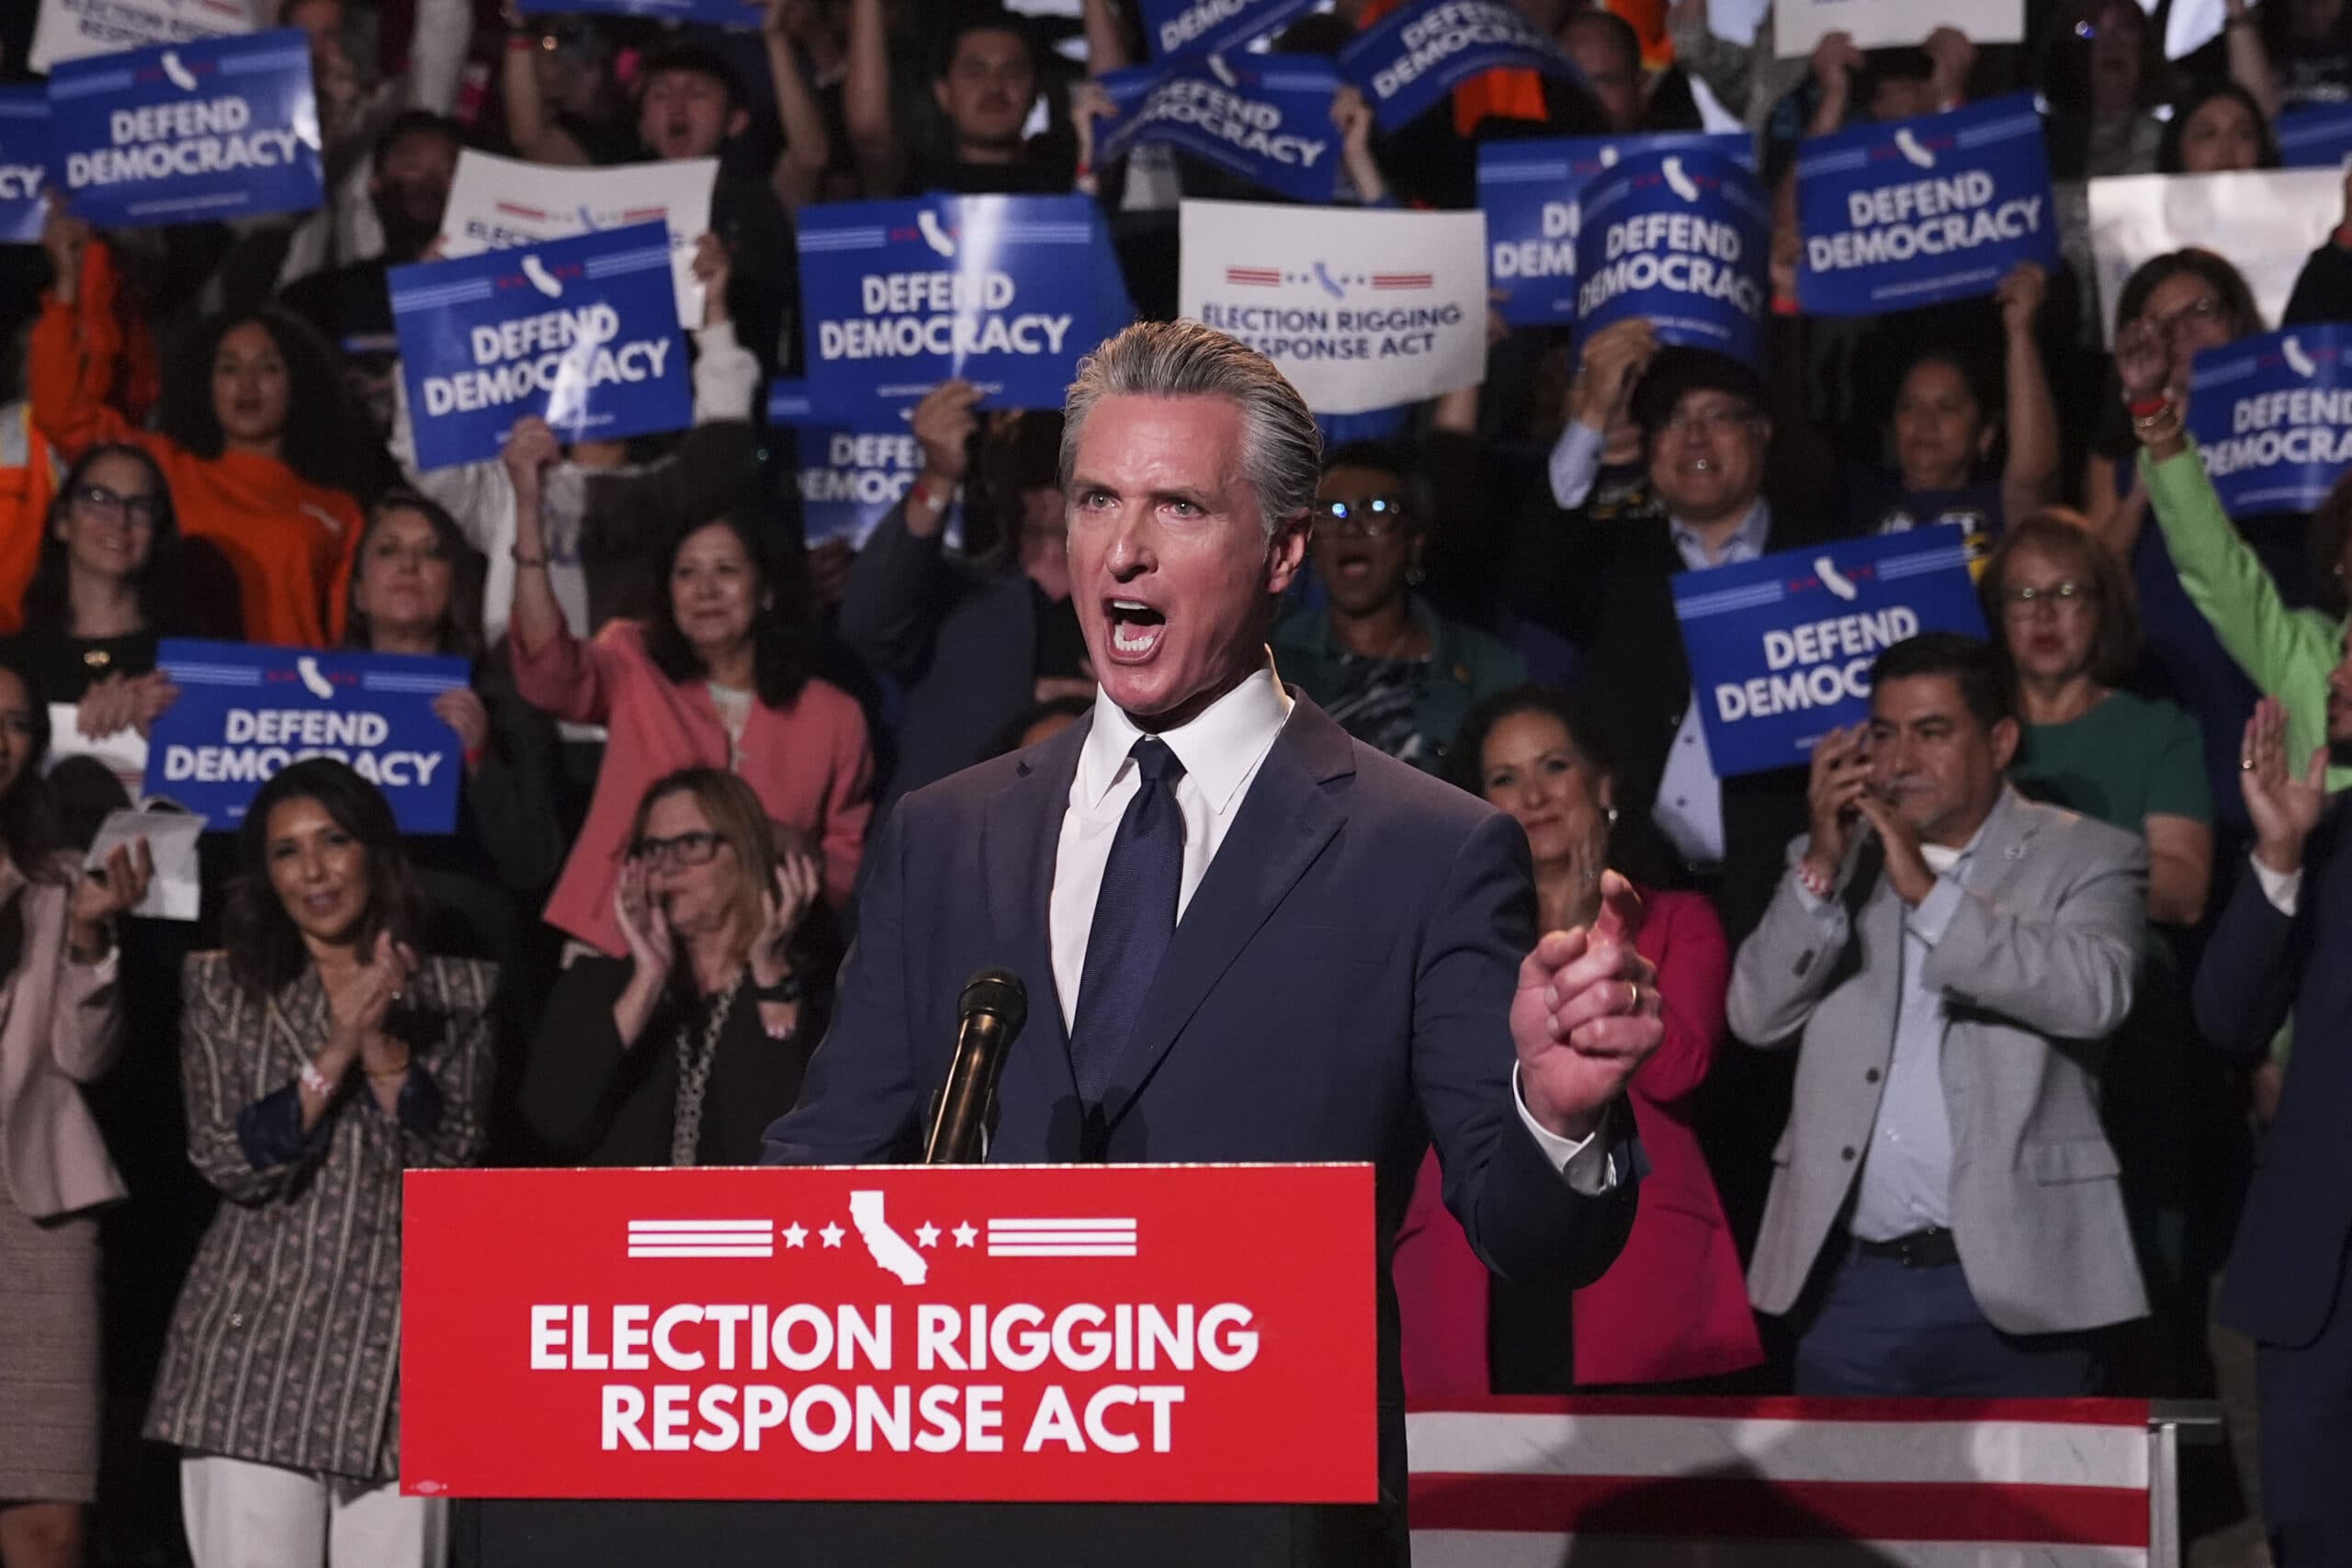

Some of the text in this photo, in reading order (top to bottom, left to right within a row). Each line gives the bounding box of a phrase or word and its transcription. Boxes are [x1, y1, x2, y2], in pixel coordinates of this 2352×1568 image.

[110, 96, 251, 145] DEFEND
[66, 130, 299, 188] DEMOCRACY
[1848, 169, 1995, 228] DEFEND
[1605, 211, 1742, 263] DEFEND
[1807, 194, 2042, 273] DEMOCRACY
[862, 270, 1015, 315] DEFEND
[1202, 301, 1464, 333] ELECTION RIGGING
[470, 302, 620, 366] DEFEND
[819, 314, 1073, 361] DEMOCRACY
[1379, 332, 1436, 359] ACT
[830, 434, 926, 468] DEFE
[1762, 605, 1919, 671] DEFEND
[1714, 656, 1872, 723] DEMOC
[225, 708, 390, 748] DEFEND
[164, 745, 444, 787] DEMOACY
[530, 1302, 1260, 1372] ELECTION RIGGING
[601, 1383, 1185, 1453] RESPONSE ACT
